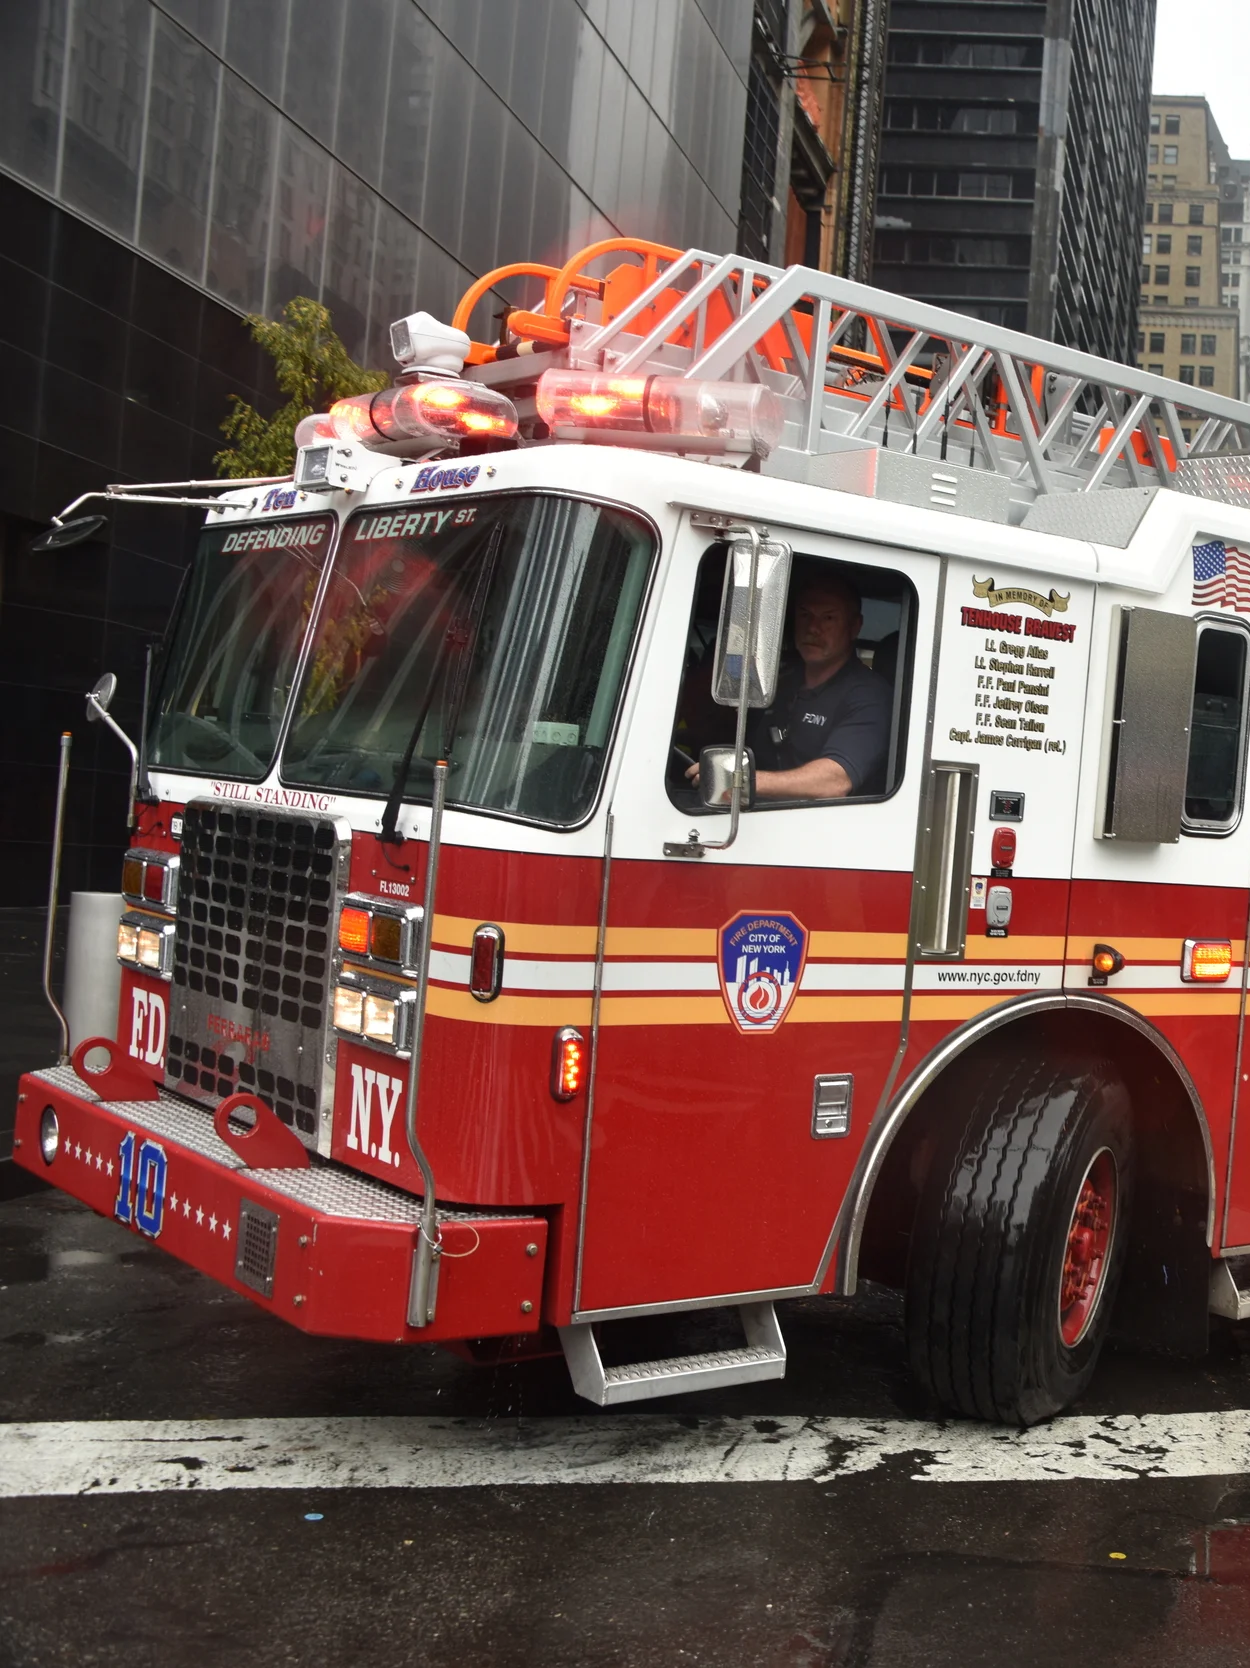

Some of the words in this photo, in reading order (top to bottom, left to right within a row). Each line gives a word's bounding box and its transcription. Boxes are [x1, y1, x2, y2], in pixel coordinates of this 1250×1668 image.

[261, 488, 298, 512] Ten
[410, 464, 481, 494] House
[354, 510, 454, 541] LIBERTY
[455, 508, 477, 524] ST.
[221, 523, 327, 555] DEFENDING
[995, 592, 1003, 602] IN
[1006, 591, 1038, 604] MEMORY
[1039, 599, 1049, 609] OF
[960, 606, 1023, 634] TENHOUSE
[1024, 616, 1076, 643] BRAVEST
[985, 638, 997, 652] Lt.
[999, 640, 1025, 659] Gregg
[974, 655, 986, 670] Lt.
[989, 657, 1024, 675] Stephen
[977, 675, 994, 690] F.F.
[996, 678, 1016, 693] Paul
[974, 693, 991, 708] F.F.
[802, 713, 827, 726] FDNY
[975, 712, 992, 727] F.F.
[994, 715, 1017, 730] Sean
[949, 728, 972, 745] Capt.
[974, 731, 1004, 747] James
[1005, 733, 1042, 752] Corrigan
[211, 781, 251, 801] "STILL
[254, 785, 336, 811] STANDING"
[379, 880, 410, 897] FL13002
[730, 927, 748, 947] FIRE
[748, 919, 798, 947] DEPARTMENT
[748, 934, 768, 943] CITY
[769, 934, 781, 943] OF
[741, 945, 761, 953] NEW
[762, 945, 786, 954] YORK
[938, 969, 1040, 985] www.nyc.gov.fdny
[129, 986, 165, 1069] F.D.
[347, 1063, 403, 1168] N.Y.
[114, 1131, 168, 1239] 10
